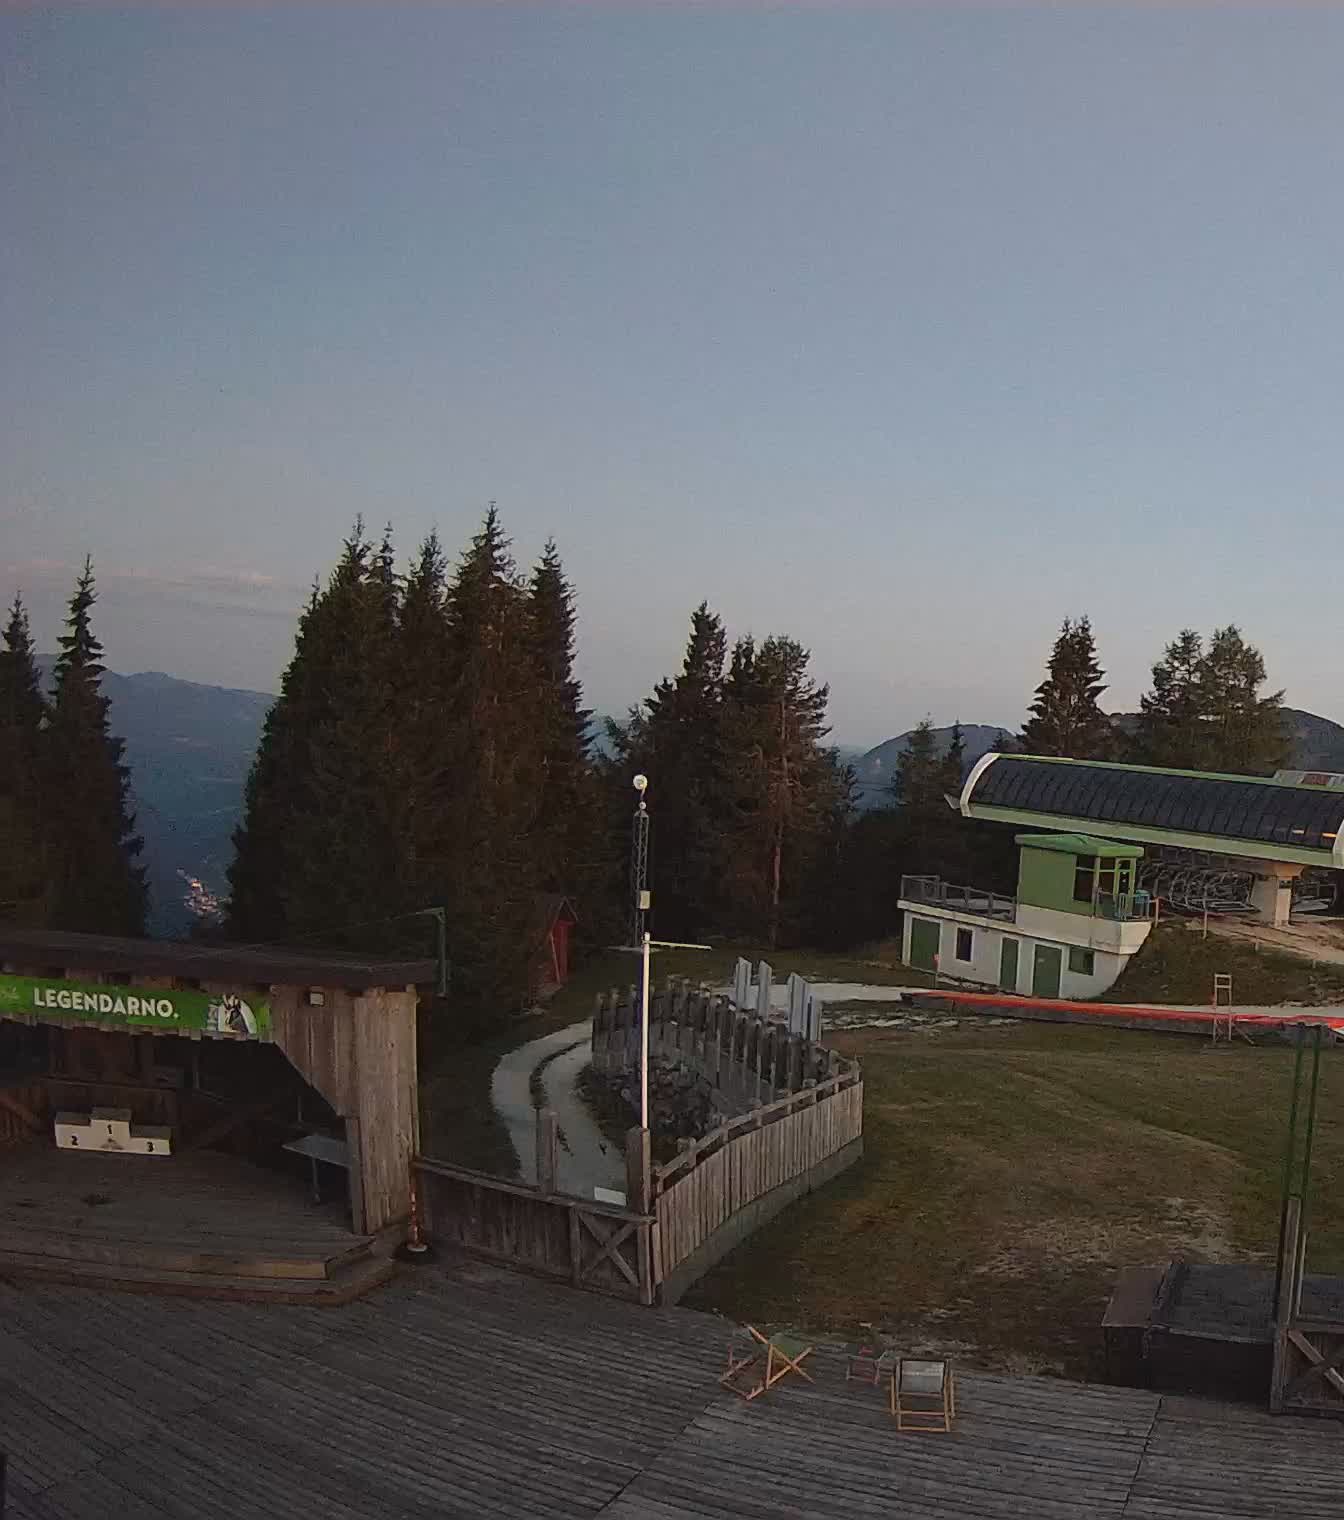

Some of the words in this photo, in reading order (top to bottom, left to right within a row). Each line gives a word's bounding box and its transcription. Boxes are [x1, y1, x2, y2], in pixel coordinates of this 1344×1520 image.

[34, 988, 179, 1018] LEGENDARNO.
[107, 1125, 113, 1135] 1
[71, 1136, 78, 1146] 2
[147, 1142, 154, 1152] 3
